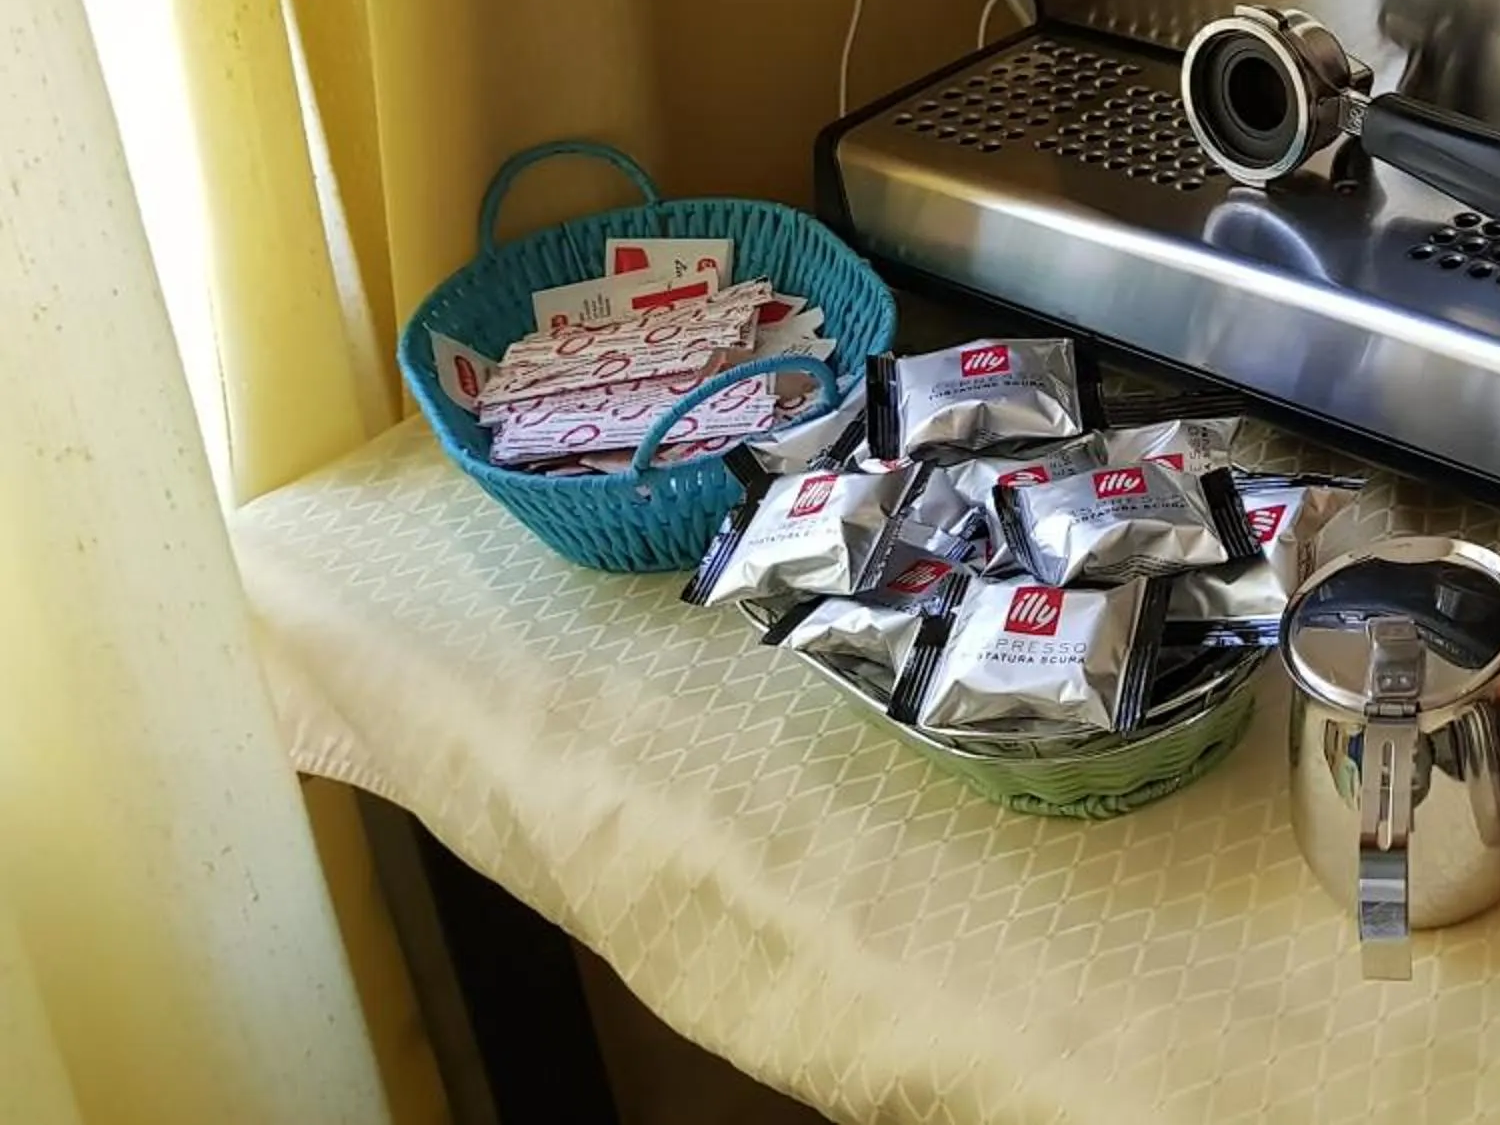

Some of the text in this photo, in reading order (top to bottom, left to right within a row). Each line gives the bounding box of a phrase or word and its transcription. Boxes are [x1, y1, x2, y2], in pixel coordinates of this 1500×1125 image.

[963, 351, 1006, 372] illy
[1098, 472, 1142, 494] illy
[1009, 592, 1059, 631] illy
[982, 638, 1088, 655] PRESSO
